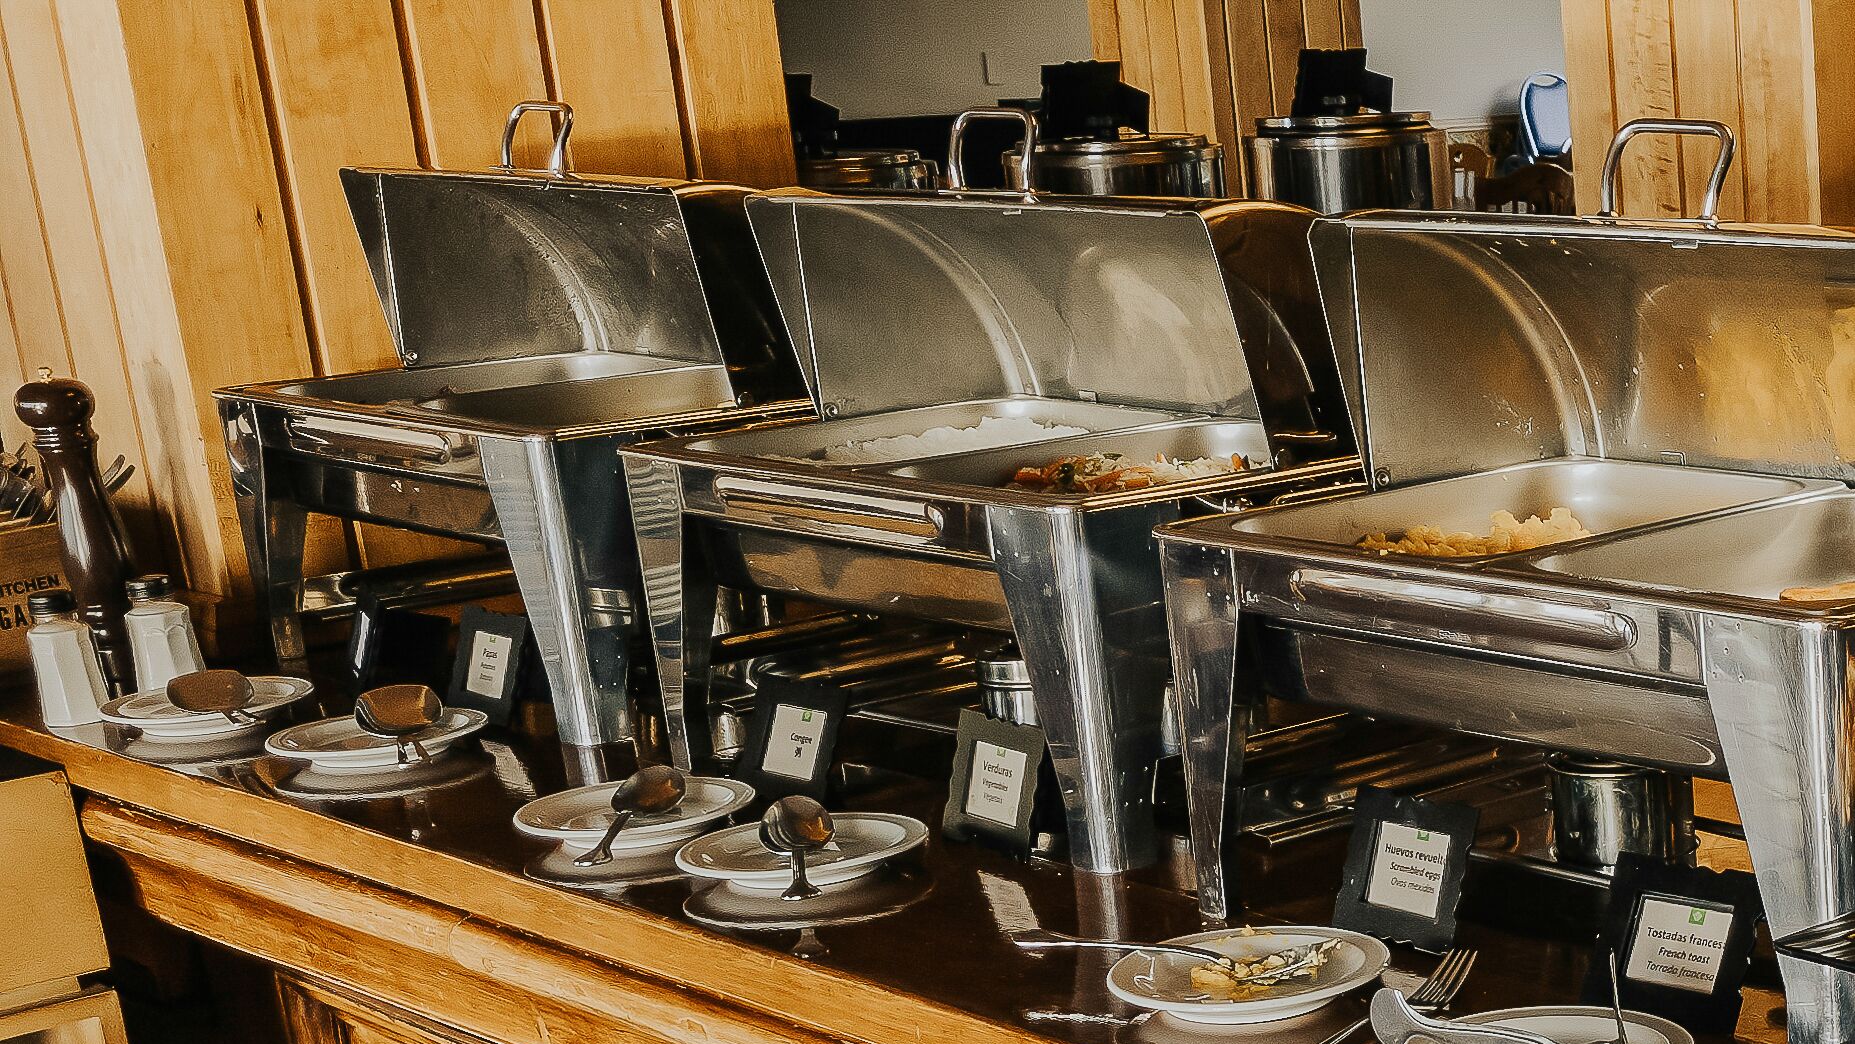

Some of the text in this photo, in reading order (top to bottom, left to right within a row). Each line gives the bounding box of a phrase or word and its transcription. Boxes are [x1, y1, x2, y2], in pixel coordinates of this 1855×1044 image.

[0, 605, 36, 631] GA
[983, 760, 1013, 778] Verduras
[1384, 843, 1414, 859] Huevos
[1425, 872, 1441, 881] eggs
[1647, 926, 1687, 943] Tostadas
[1658, 946, 1711, 965] French toast
[1646, 960, 1678, 975] Torrada
